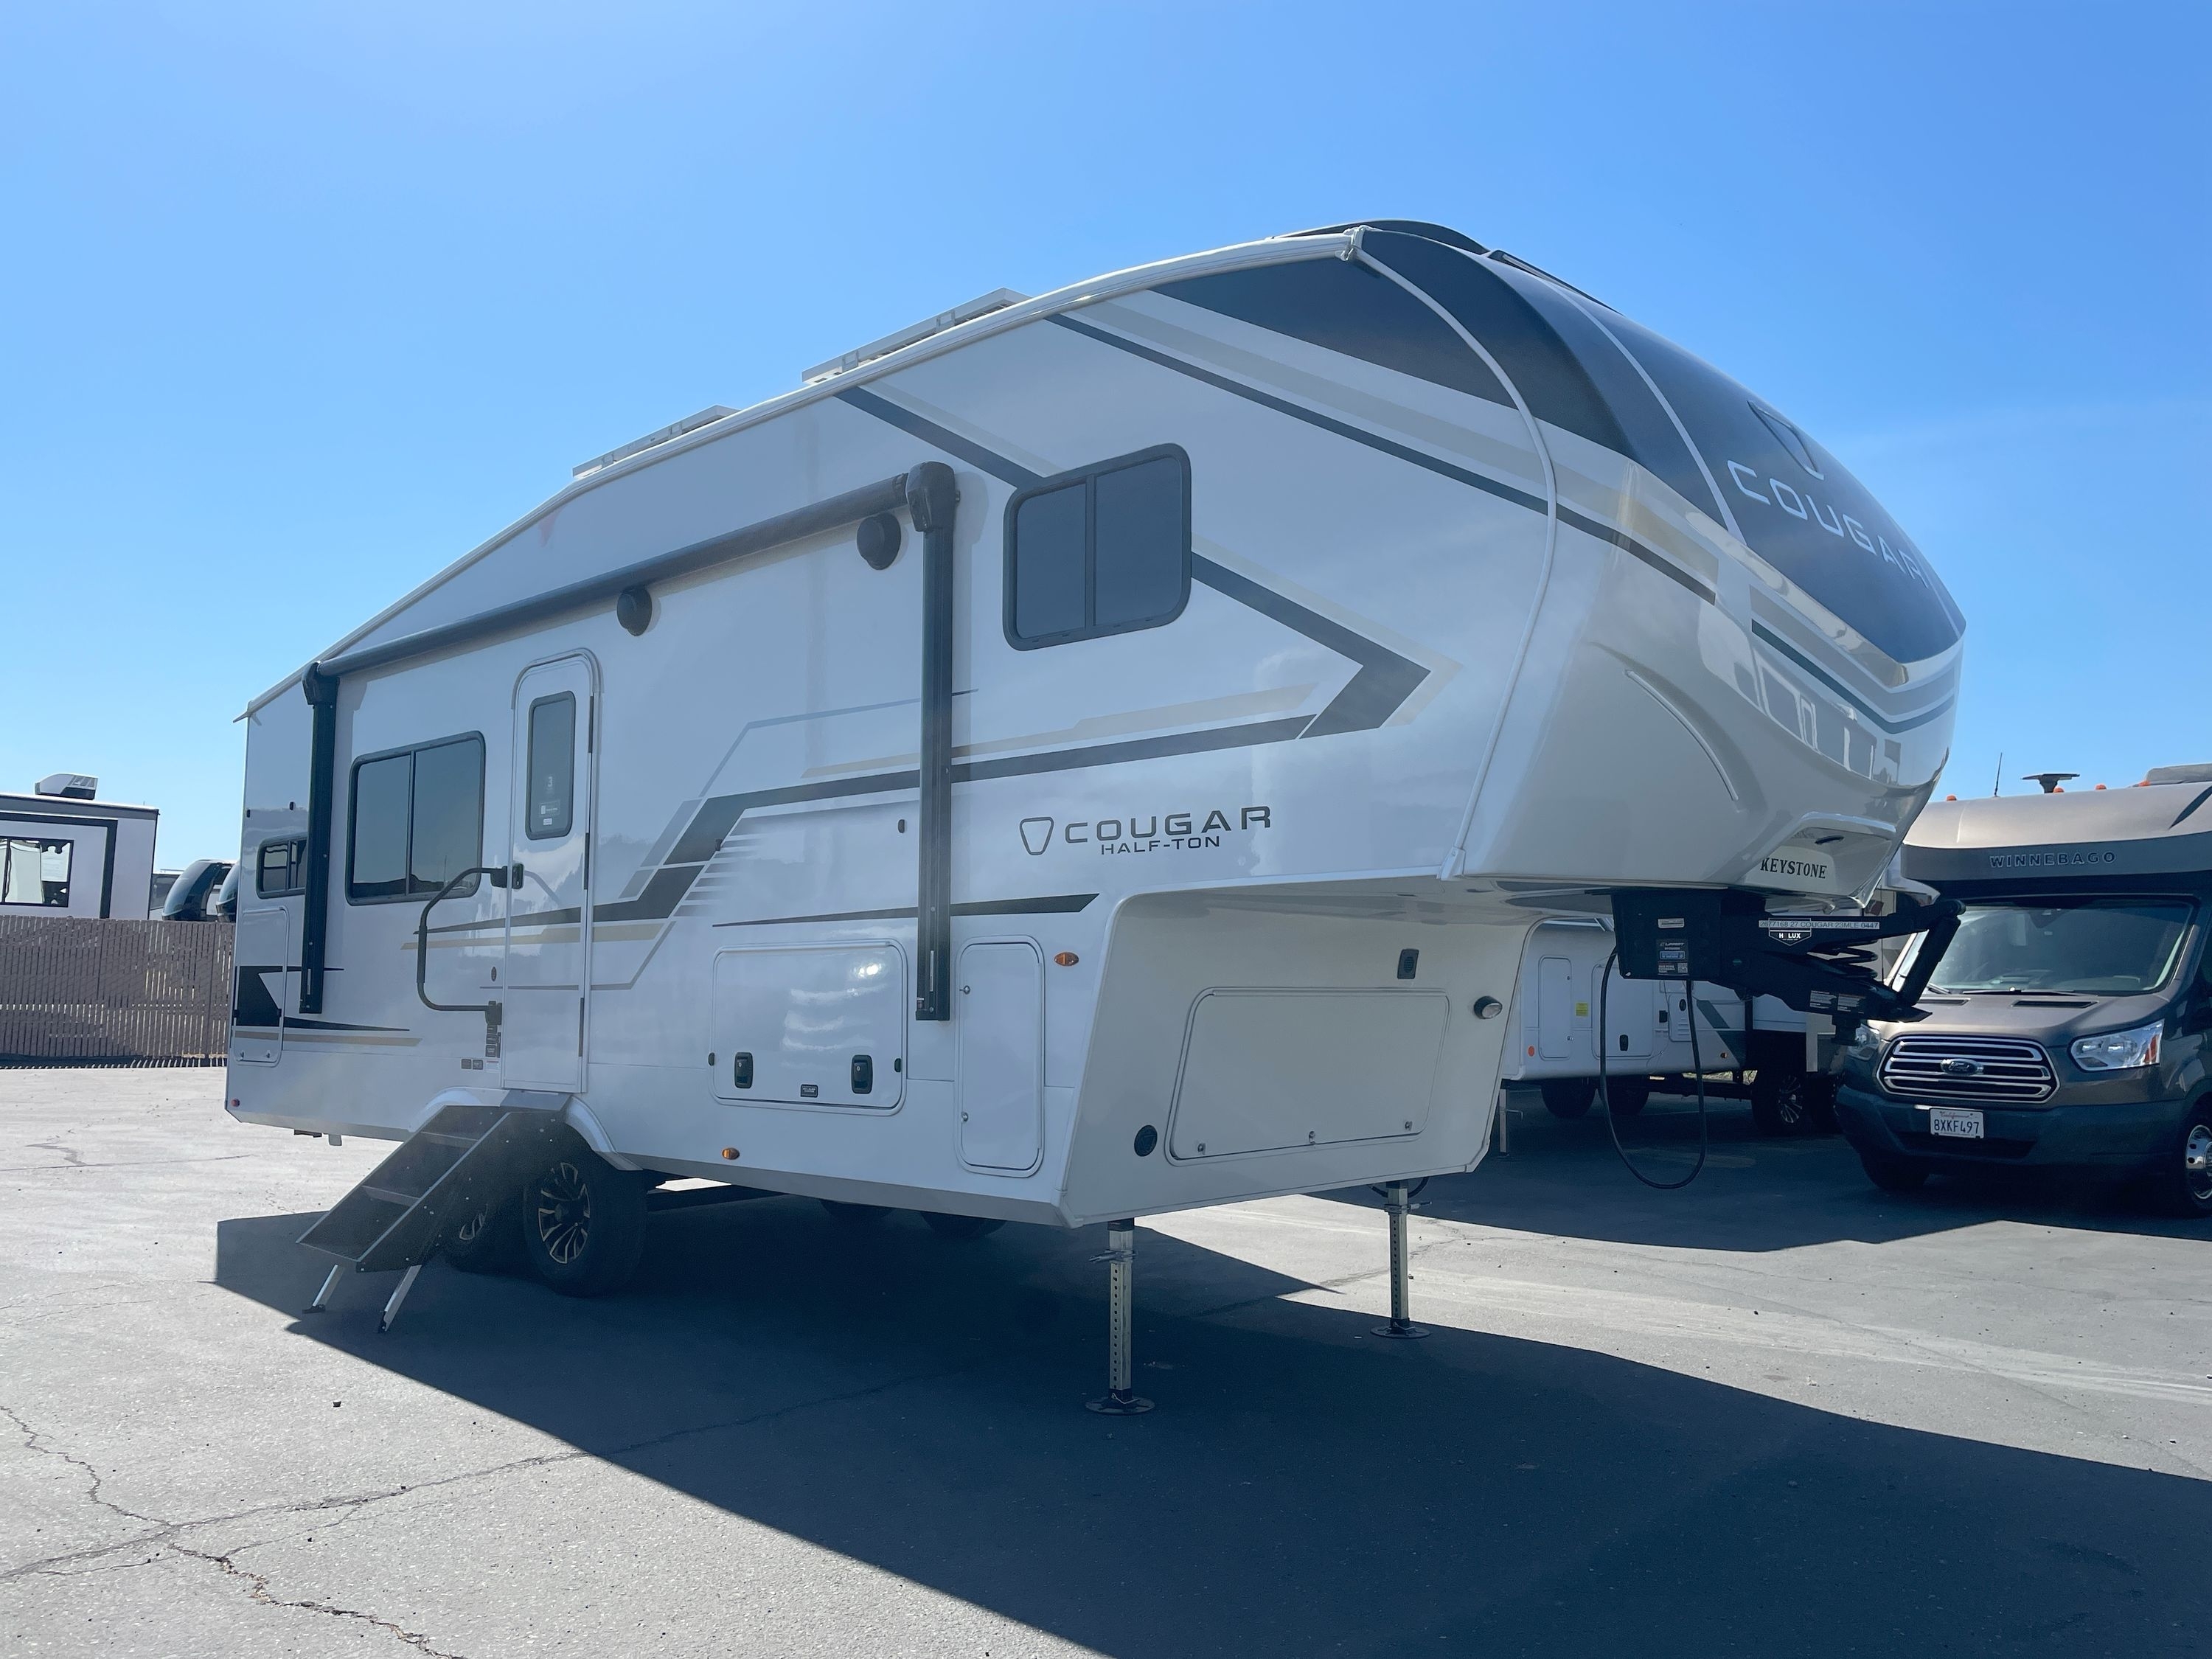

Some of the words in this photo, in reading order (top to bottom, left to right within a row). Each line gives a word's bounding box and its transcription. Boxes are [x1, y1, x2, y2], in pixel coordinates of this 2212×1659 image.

[1727, 459, 1929, 588] COUGAR
[1065, 806, 1270, 844] COUGAR
[1101, 835, 1220, 855] HALF-TON
[1760, 858, 1827, 879] KEYSTONE
[1989, 852, 2116, 868] WINNEBAGO
[1934, 1119, 1980, 1134] 8XKF497
